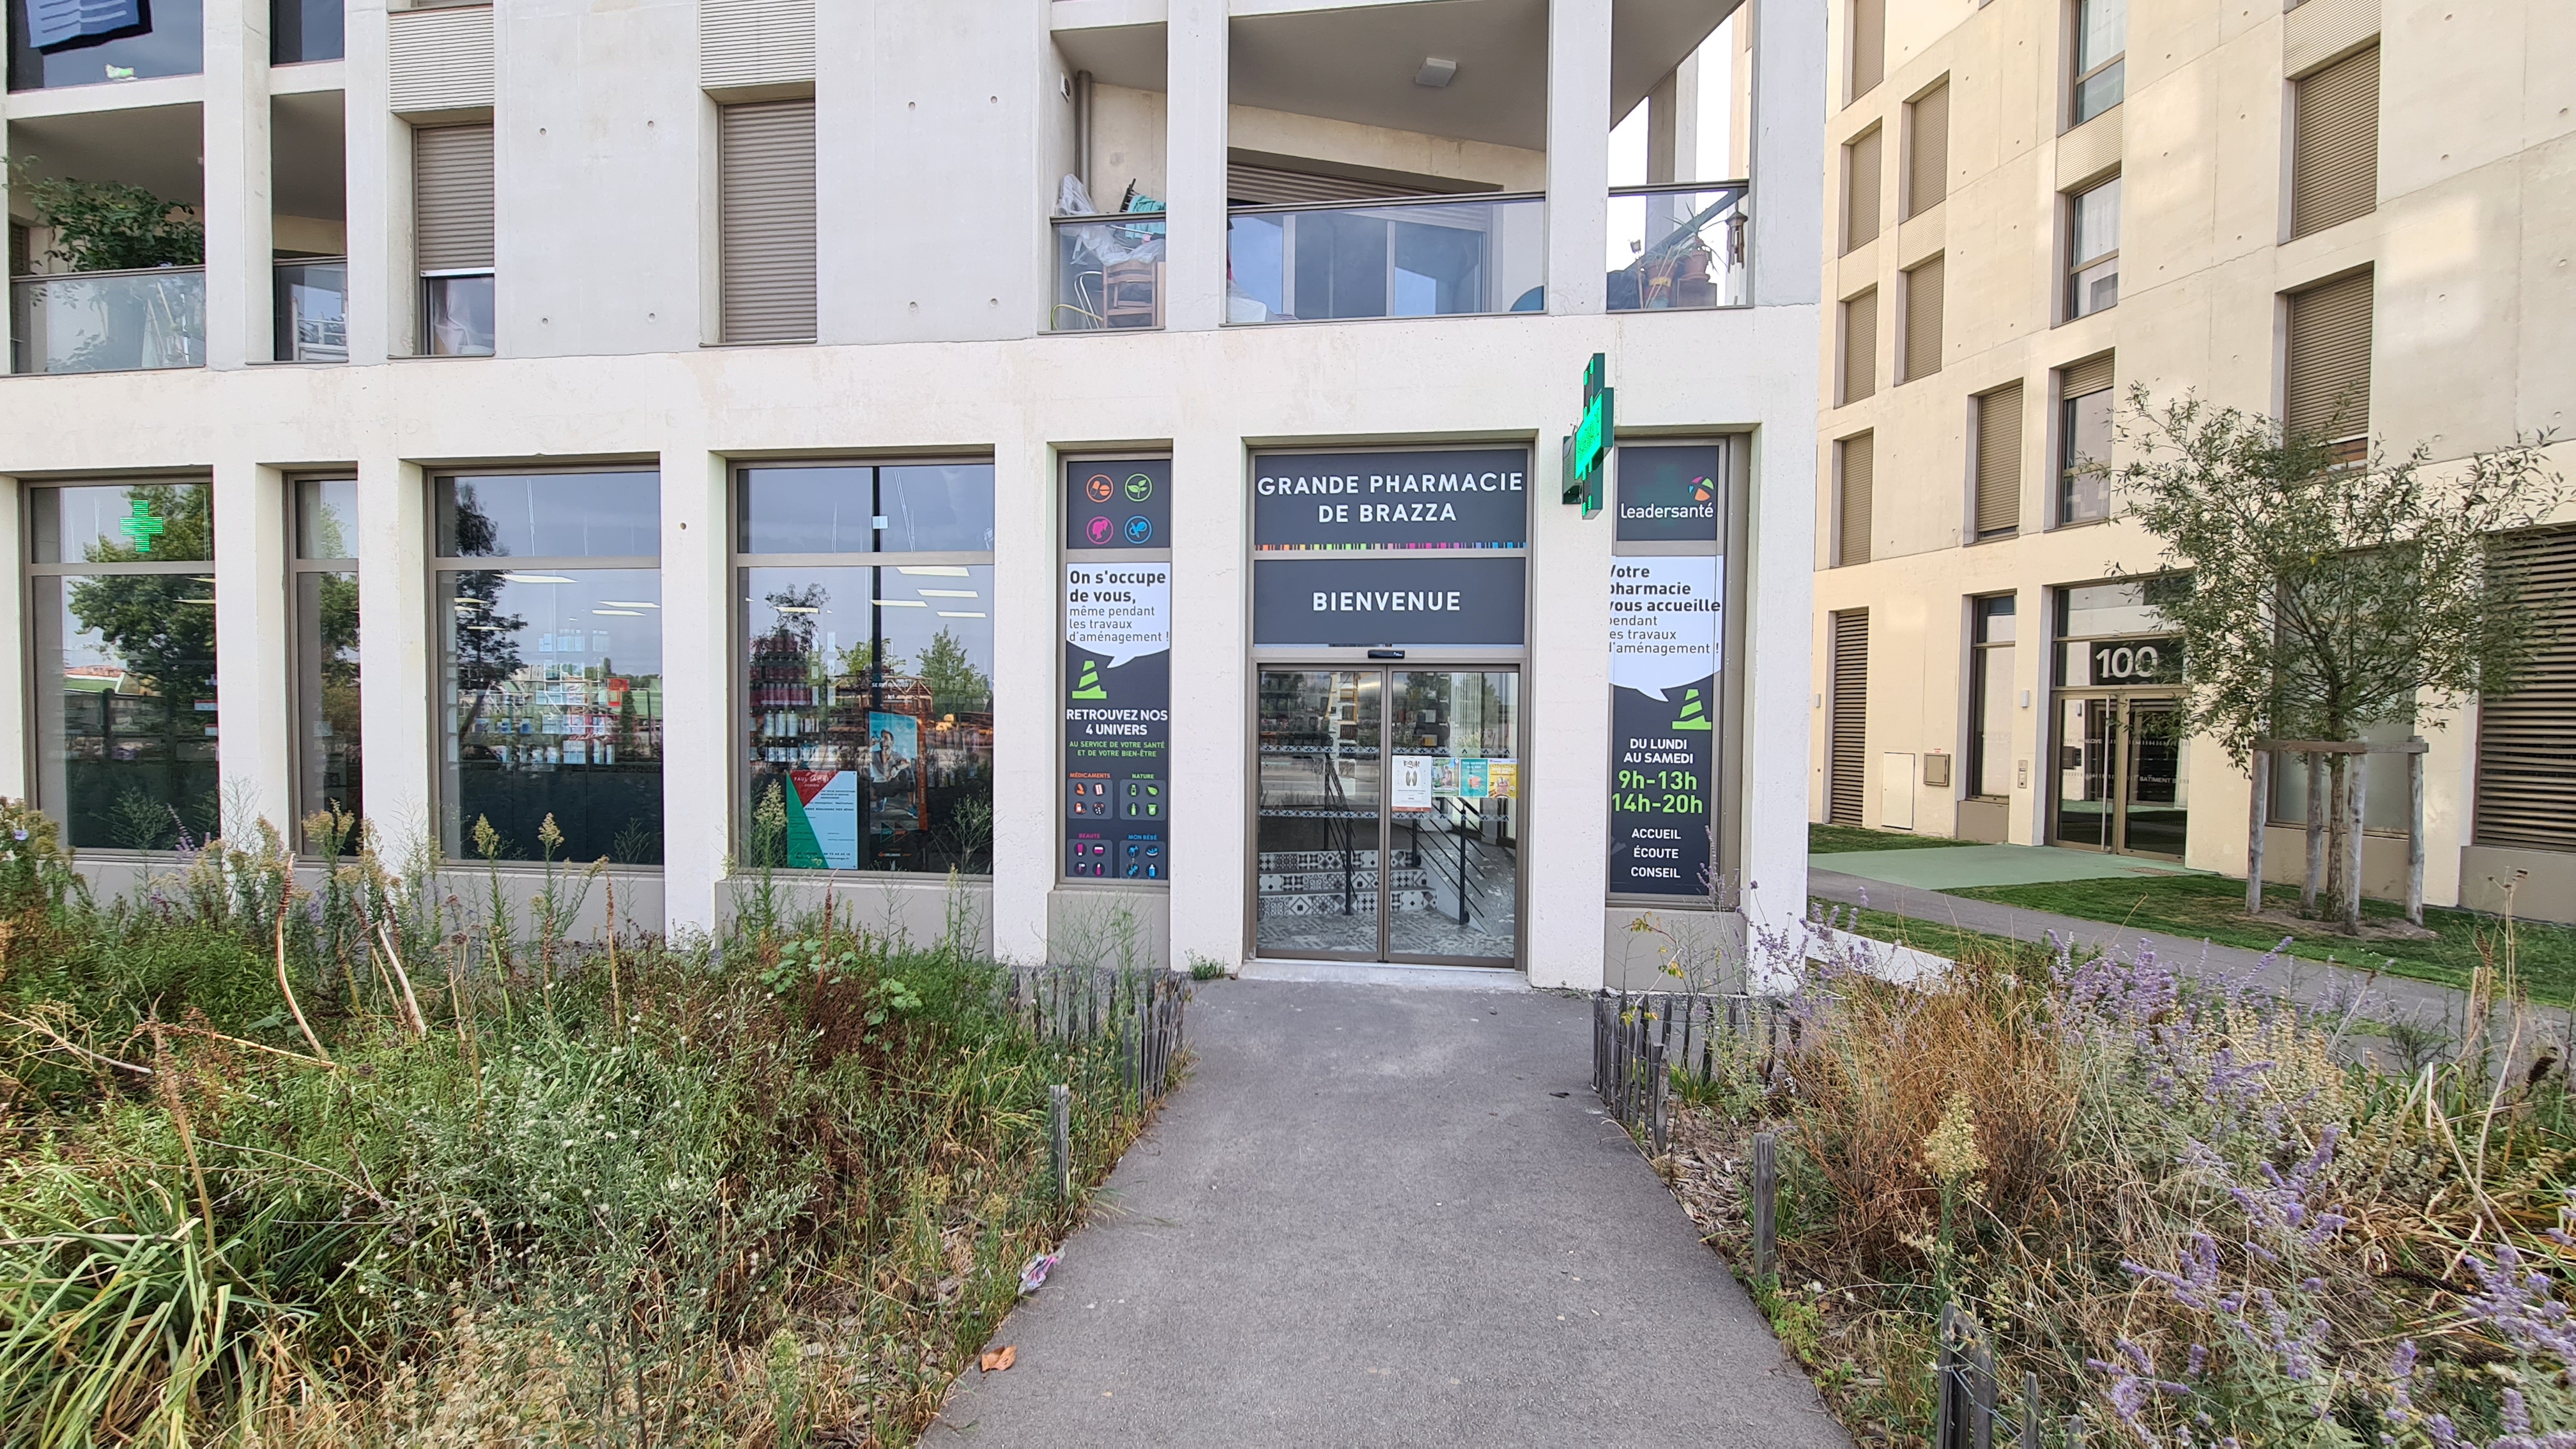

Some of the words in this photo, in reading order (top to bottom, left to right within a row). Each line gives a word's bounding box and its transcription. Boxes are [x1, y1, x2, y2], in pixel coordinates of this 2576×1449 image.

[1257, 476, 1359, 495] GRANDE
[1370, 472, 1523, 493] PHARMACIE
[1319, 504, 1348, 523] DE
[1360, 503, 1457, 522] BRAZZA
[1070, 571, 1091, 584] On
[1095, 571, 1166, 586] s'occupe
[1070, 589, 1089, 602] de
[1093, 592, 1136, 604] vous,
[1313, 591, 1460, 611] BIENVENUE
[1647, 599, 1721, 611] accueille
[1069, 605, 1105, 616] même
[1108, 606, 1155, 618] pendant
[1069, 619, 1087, 629] les
[1089, 620, 1132, 629] travaux
[1609, 615, 1657, 625] endant
[1069, 631, 1162, 644] d'aménagement
[1628, 629, 1676, 640] travaux
[2096, 646, 2158, 678] 100
[1066, 709, 1138, 721] RETROUVEZ
[1140, 709, 1168, 721] NOS
[1086, 724, 1093, 735] 4
[1096, 724, 1147, 735] UNIVERS
[1143, 740, 1165, 749] SANTÉ
[1630, 739, 1646, 749] DU
[1650, 739, 1687, 749] LUNDI
[1121, 749, 1157, 757] BIEN-ÊTRE
[1623, 753, 1641, 763] AU
[1644, 753, 1693, 763] SAMEDI
[1618, 770, 1697, 790] 9h-13h
[1612, 793, 1703, 814] 14h-20h
[1631, 829, 1682, 839] ACCUEIL
[1634, 845, 1679, 859] ÉCOUTE
[1630, 867, 1681, 878] CONSEIL
